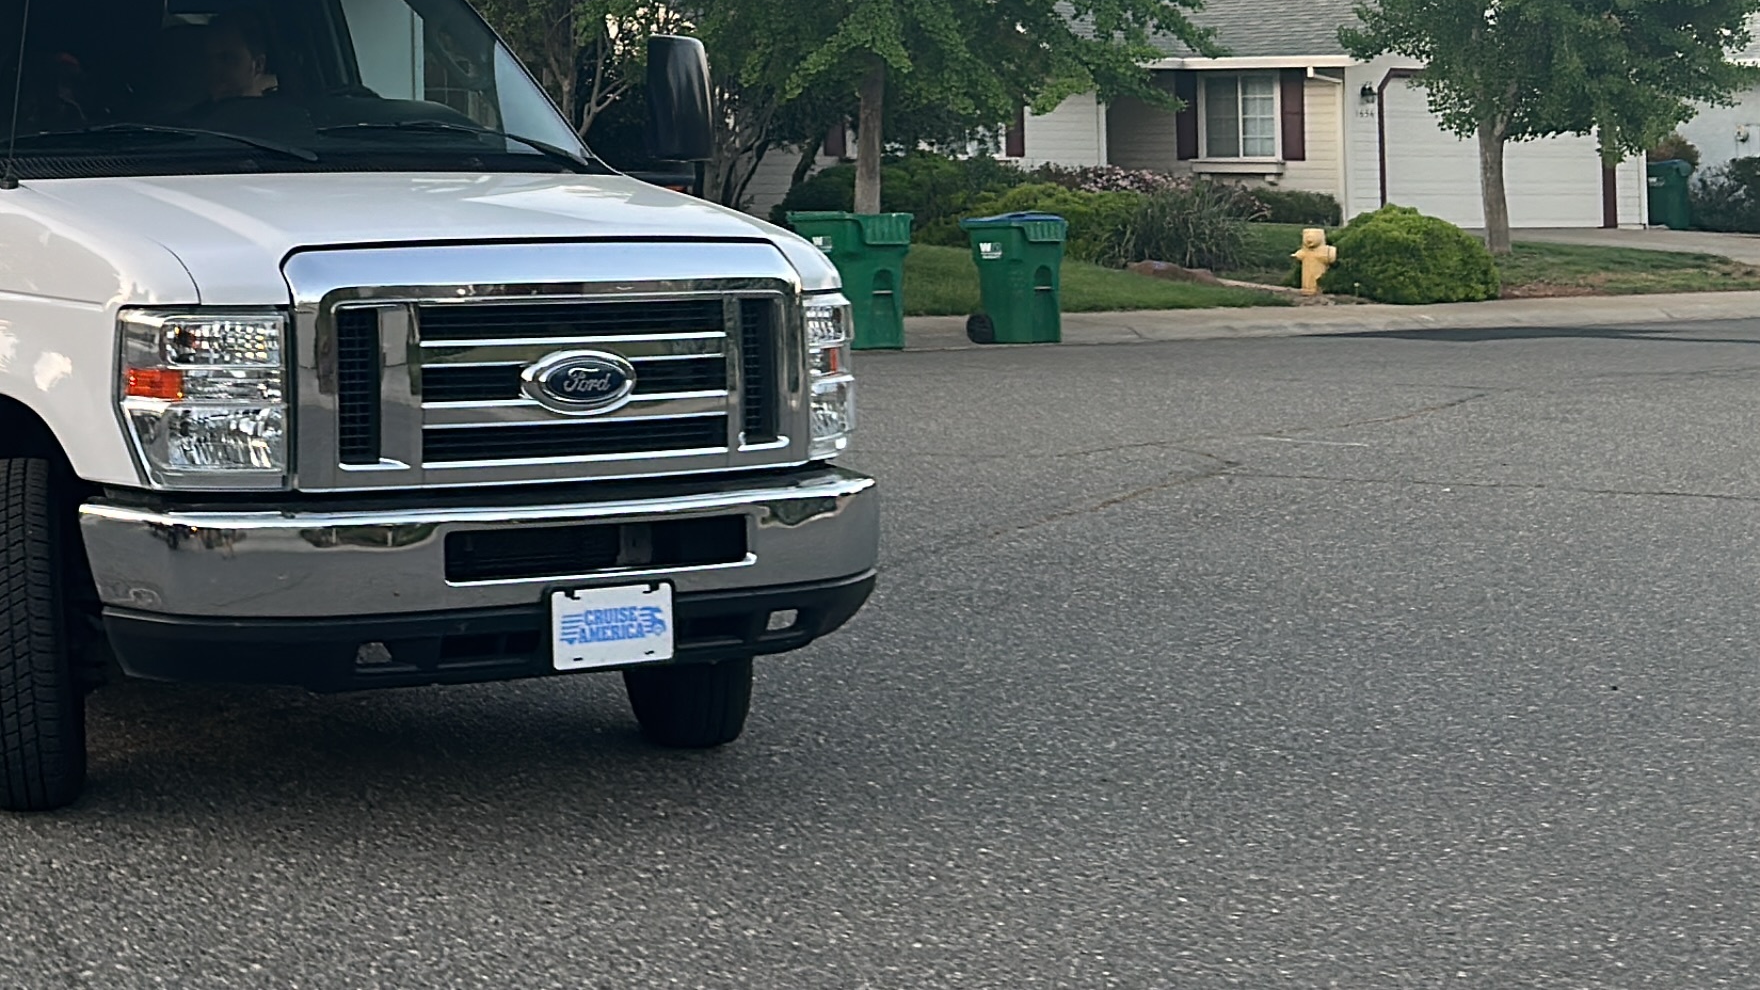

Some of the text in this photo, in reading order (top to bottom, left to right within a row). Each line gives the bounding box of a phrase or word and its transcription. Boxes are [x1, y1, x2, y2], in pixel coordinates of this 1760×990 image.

[563, 367, 612, 392] Ford
[584, 606, 638, 626] CRUISE
[578, 622, 646, 644] AMERICA
